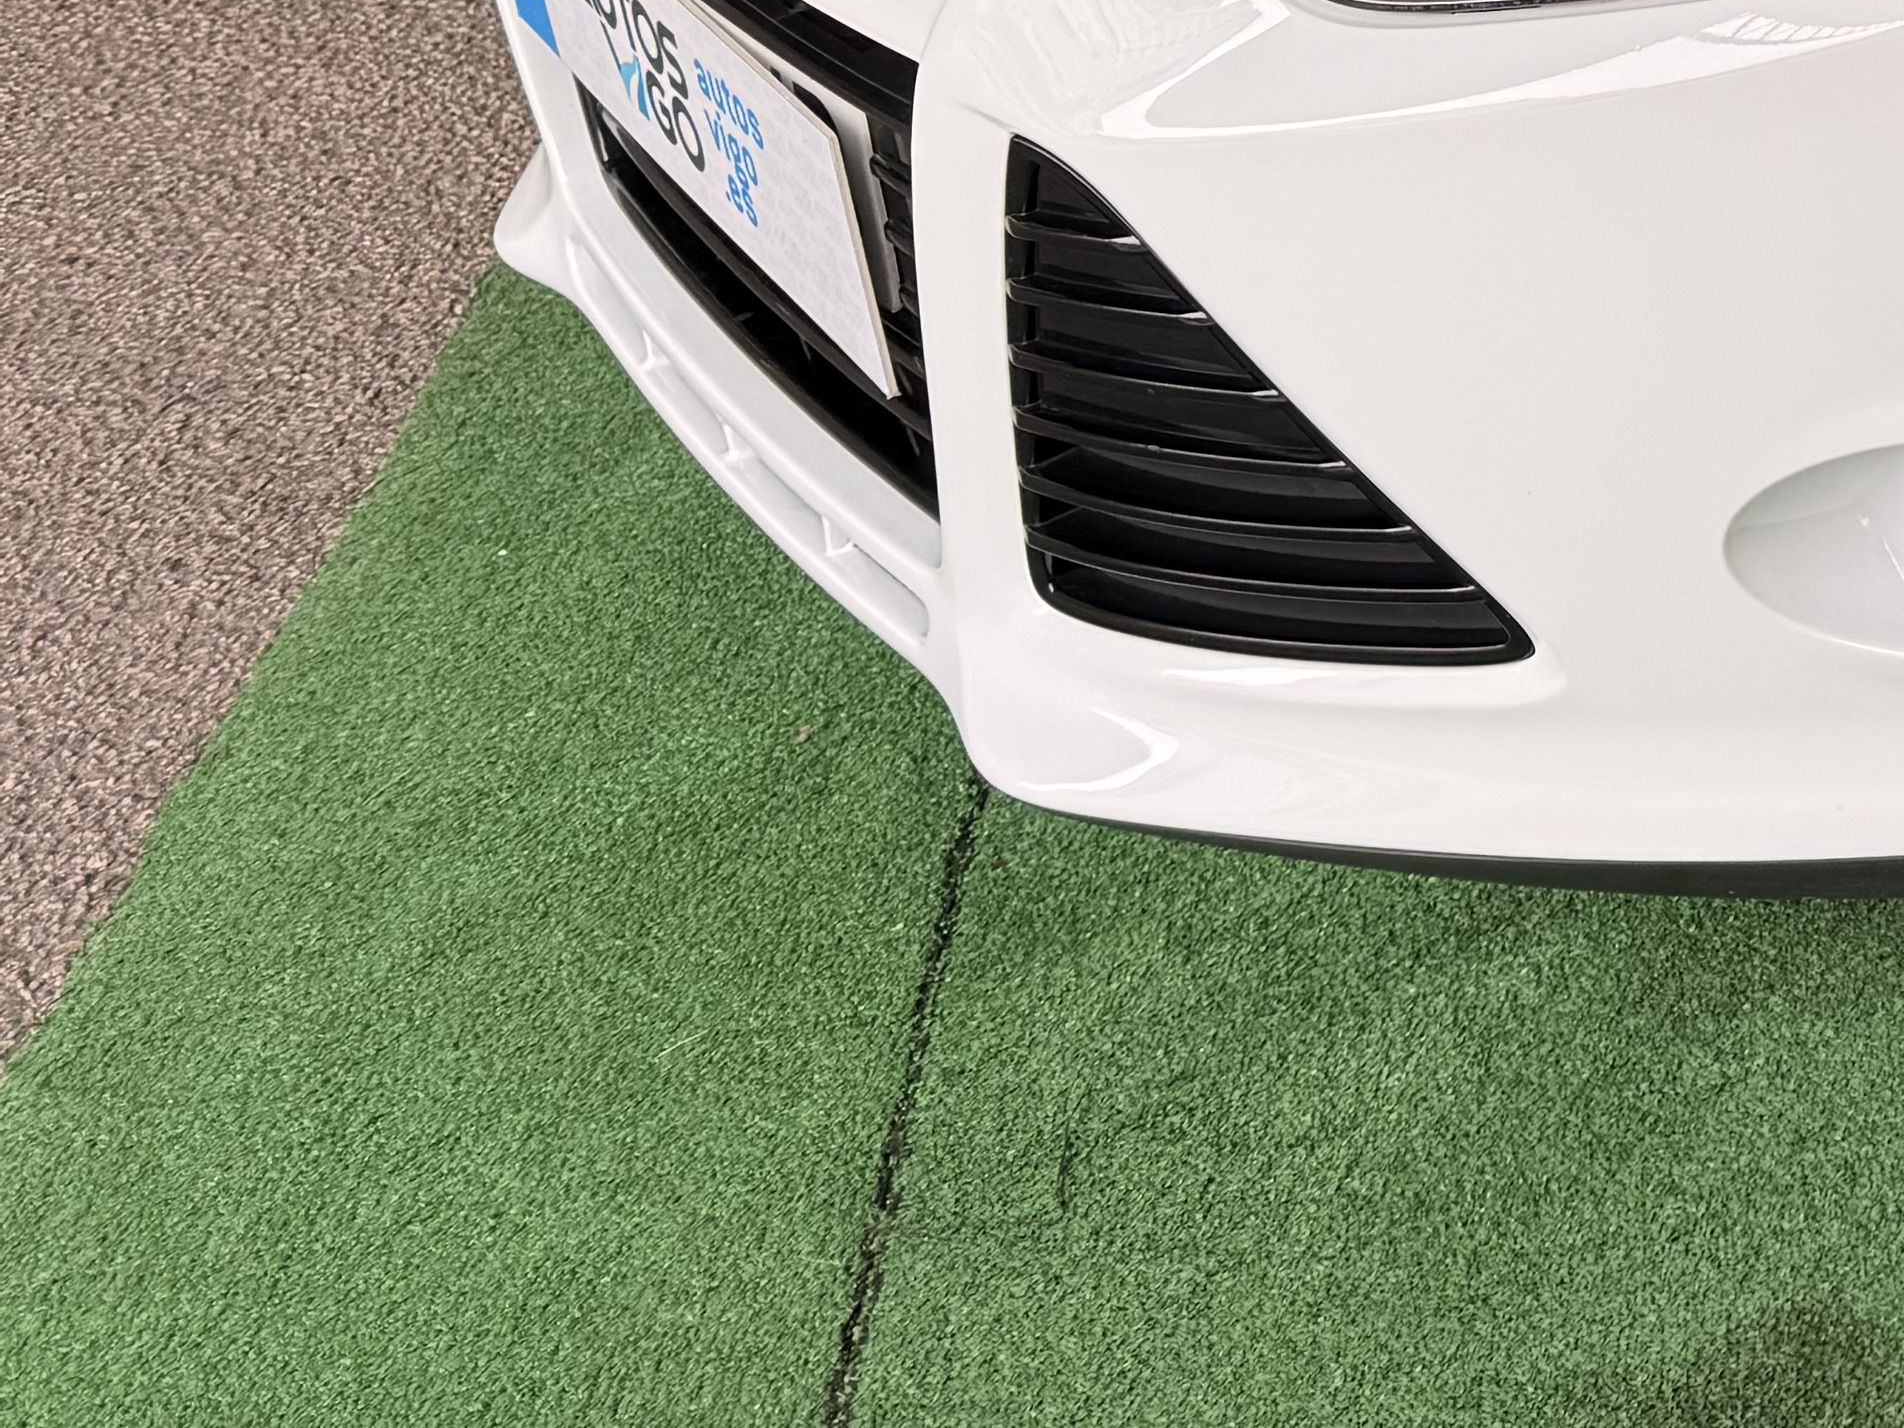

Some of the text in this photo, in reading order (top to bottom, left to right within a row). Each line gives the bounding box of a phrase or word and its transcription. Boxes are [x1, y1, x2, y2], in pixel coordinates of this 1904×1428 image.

[599, 19, 706, 173] VIGO
[694, 58, 764, 150] autos
[704, 108, 759, 190] vigo
